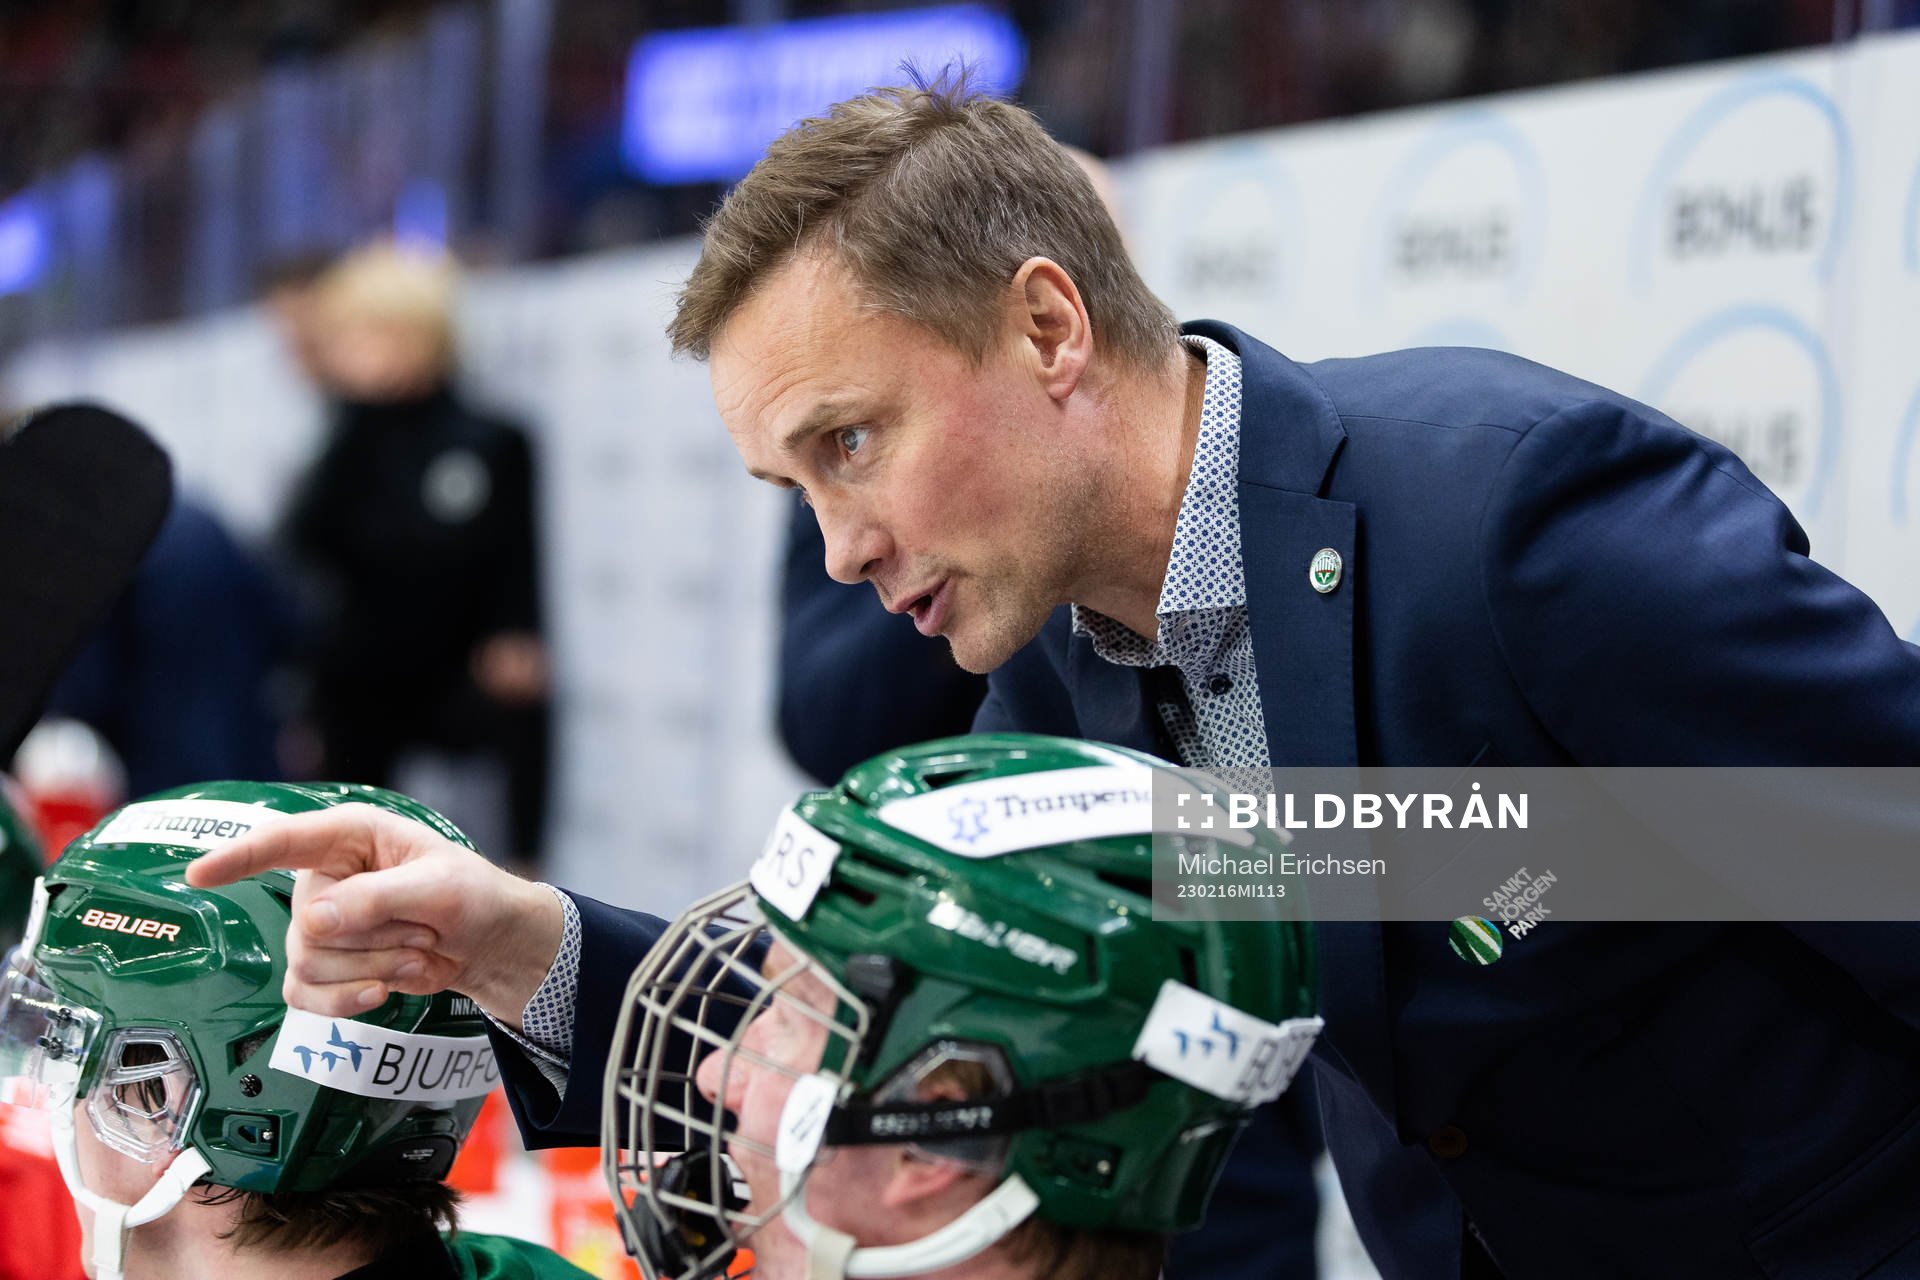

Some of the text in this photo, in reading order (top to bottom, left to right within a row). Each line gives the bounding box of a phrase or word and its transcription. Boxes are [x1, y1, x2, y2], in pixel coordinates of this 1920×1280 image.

[1483, 867, 1532, 912] SANKT
[1499, 869, 1558, 926] JÖRGEN
[1508, 902, 1552, 940] PARK
